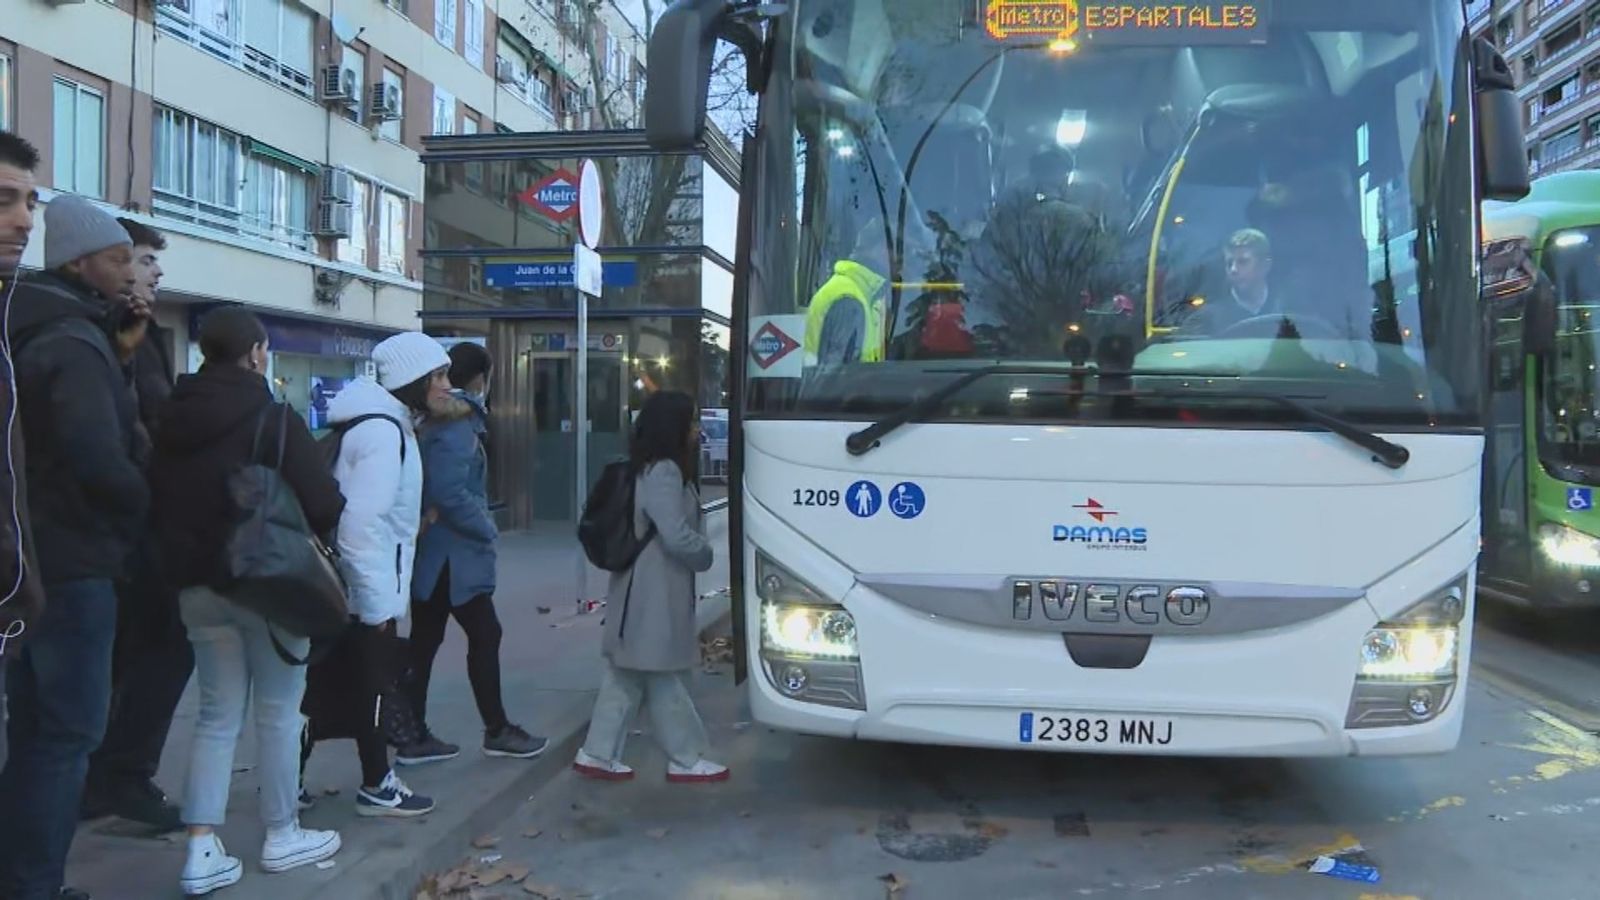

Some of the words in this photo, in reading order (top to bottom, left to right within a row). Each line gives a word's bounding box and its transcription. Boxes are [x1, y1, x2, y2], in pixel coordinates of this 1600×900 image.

[1000, 6, 1065, 25] Metro
[1085, 6, 1257, 27] ESPARTALES
[515, 264, 540, 275] Juan
[542, 264, 556, 275] de
[558, 264, 568, 275] la
[793, 488, 840, 506] 1209
[1053, 524, 1148, 544] DAMAS
[1012, 579, 1211, 626] IVECO
[1038, 716, 1109, 743] 2383
[1119, 719, 1173, 745] MNJ
